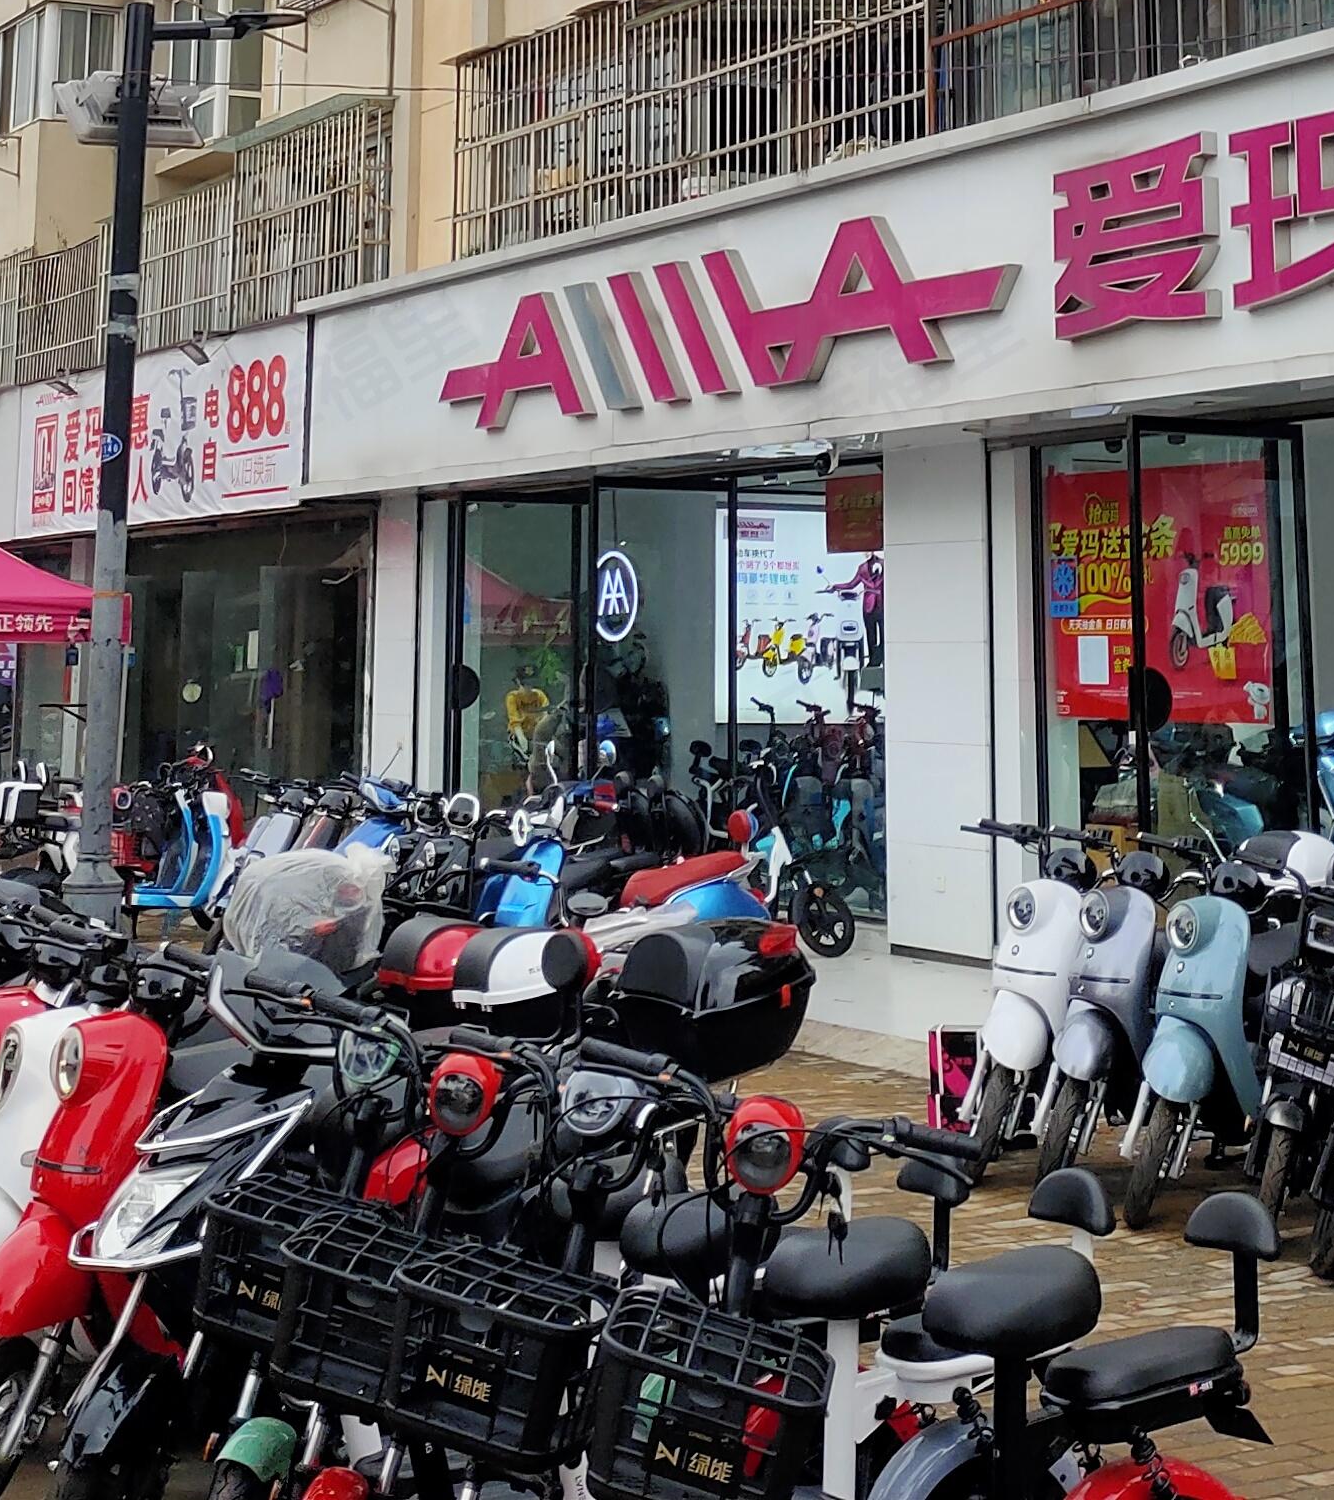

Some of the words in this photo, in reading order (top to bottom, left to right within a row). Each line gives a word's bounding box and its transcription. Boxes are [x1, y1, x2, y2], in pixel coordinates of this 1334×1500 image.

[227, 355, 286, 443] 888
[1219, 541, 1265, 567] 5999
[453, 1376, 492, 1402] 绿能
[687, 1452, 734, 1483] 绿能
